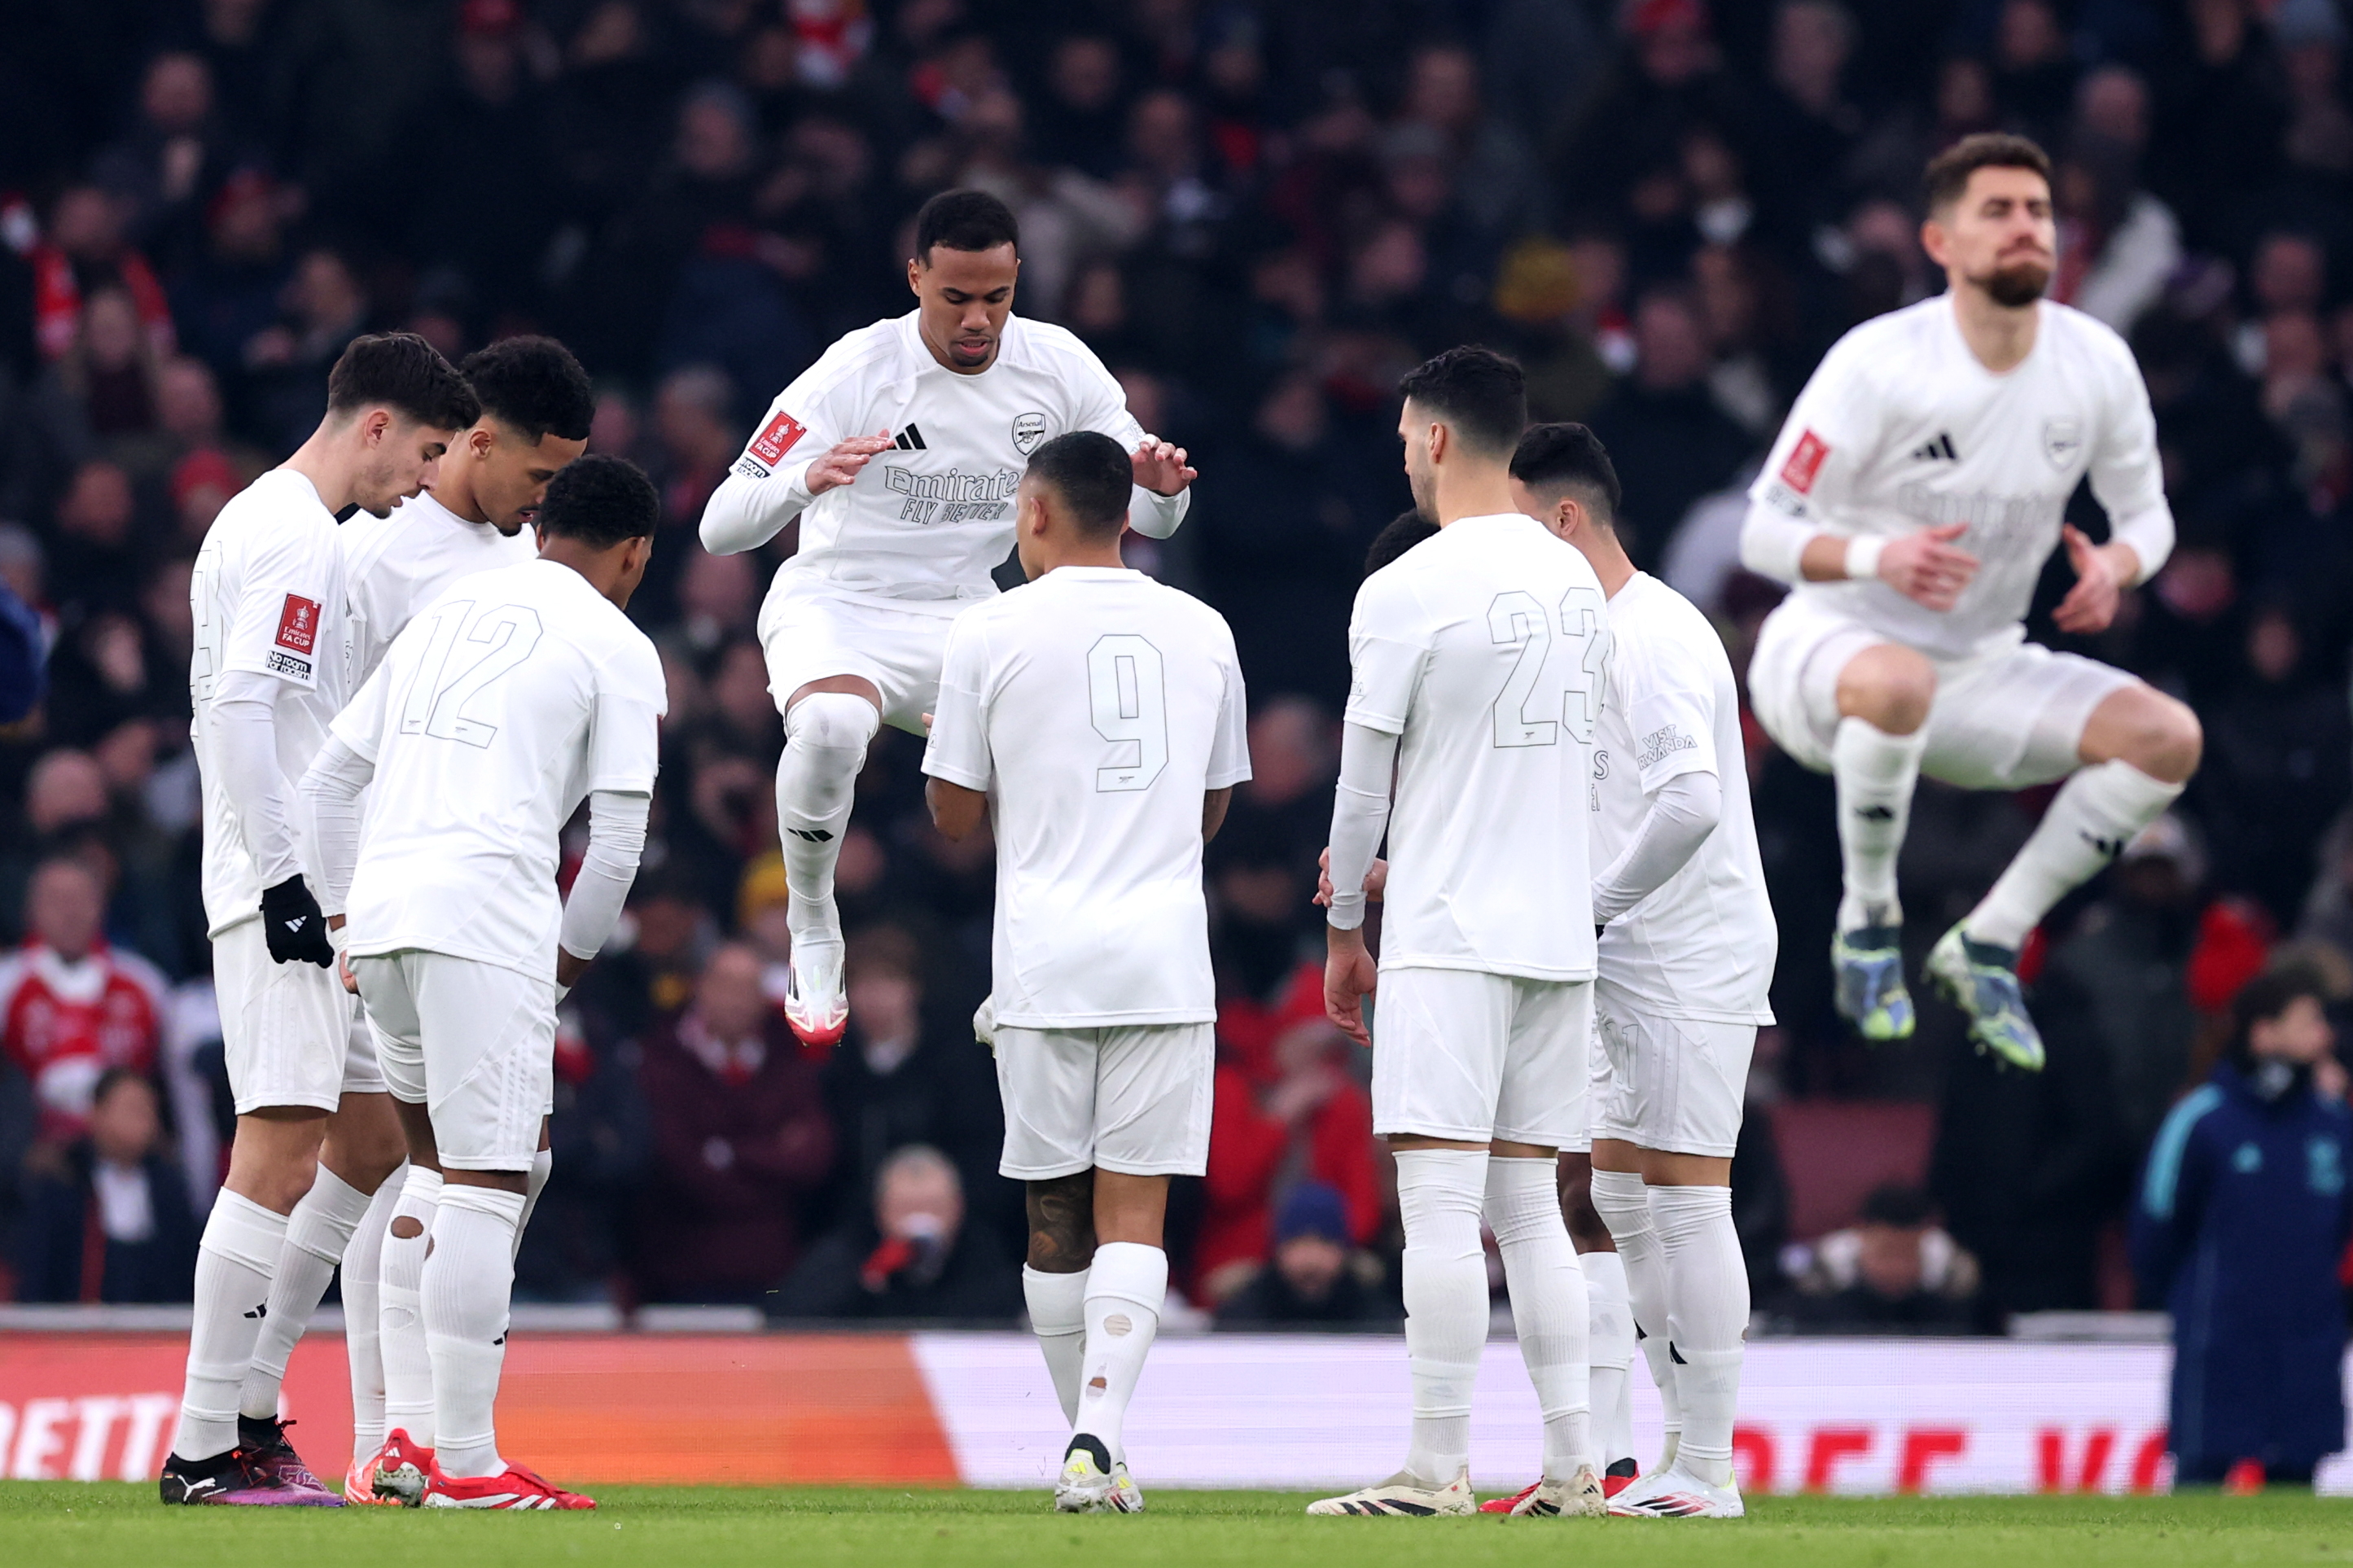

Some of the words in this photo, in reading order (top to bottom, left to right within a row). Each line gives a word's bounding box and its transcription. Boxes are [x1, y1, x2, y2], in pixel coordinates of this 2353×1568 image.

[755, 442, 764, 452] FA
[762, 447, 778, 458] CUP
[884, 466, 1026, 501] Emirate
[900, 498, 938, 524] FLY
[939, 502, 1008, 523] BETTER
[282, 633, 292, 642] FA
[294, 637, 309, 646] CUP
[284, 626, 311, 640] Emirates
[266, 659, 282, 670] for
[280, 664, 310, 680] racism
[269, 650, 283, 663] No
[283, 657, 308, 672] room
[1487, 587, 1610, 748] 23
[400, 599, 543, 749] 12
[1087, 634, 1169, 793] 9
[1642, 725, 1676, 749] VISIT
[1637, 735, 1698, 771] RWANDA
